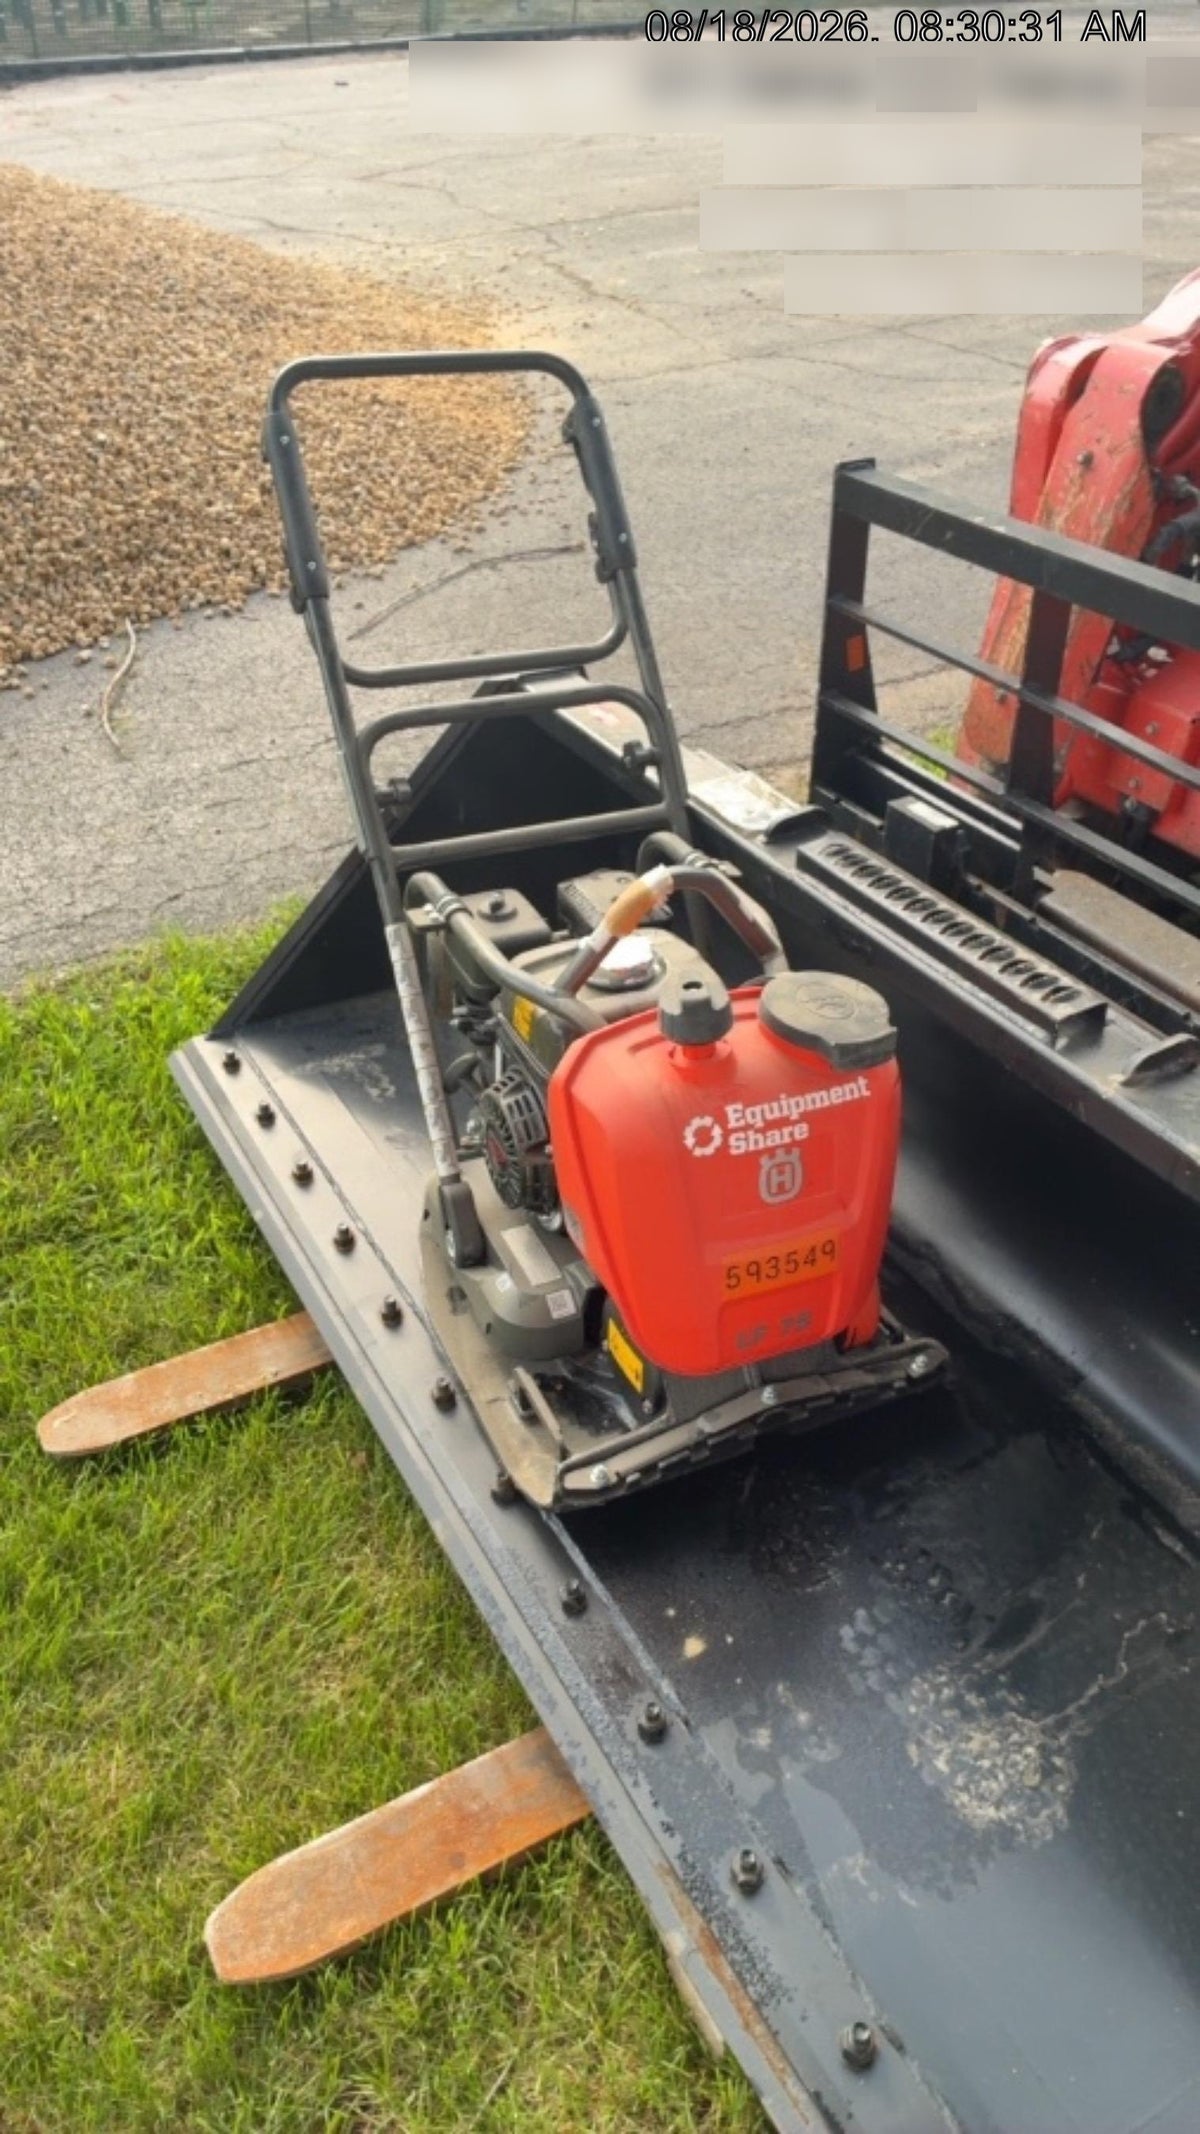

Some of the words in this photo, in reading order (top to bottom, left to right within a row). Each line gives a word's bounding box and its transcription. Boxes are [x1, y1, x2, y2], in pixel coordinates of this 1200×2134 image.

[725, 1076, 871, 1128] Equipment
[728, 1121, 810, 1155] Share
[726, 1239, 836, 1290] 593549
